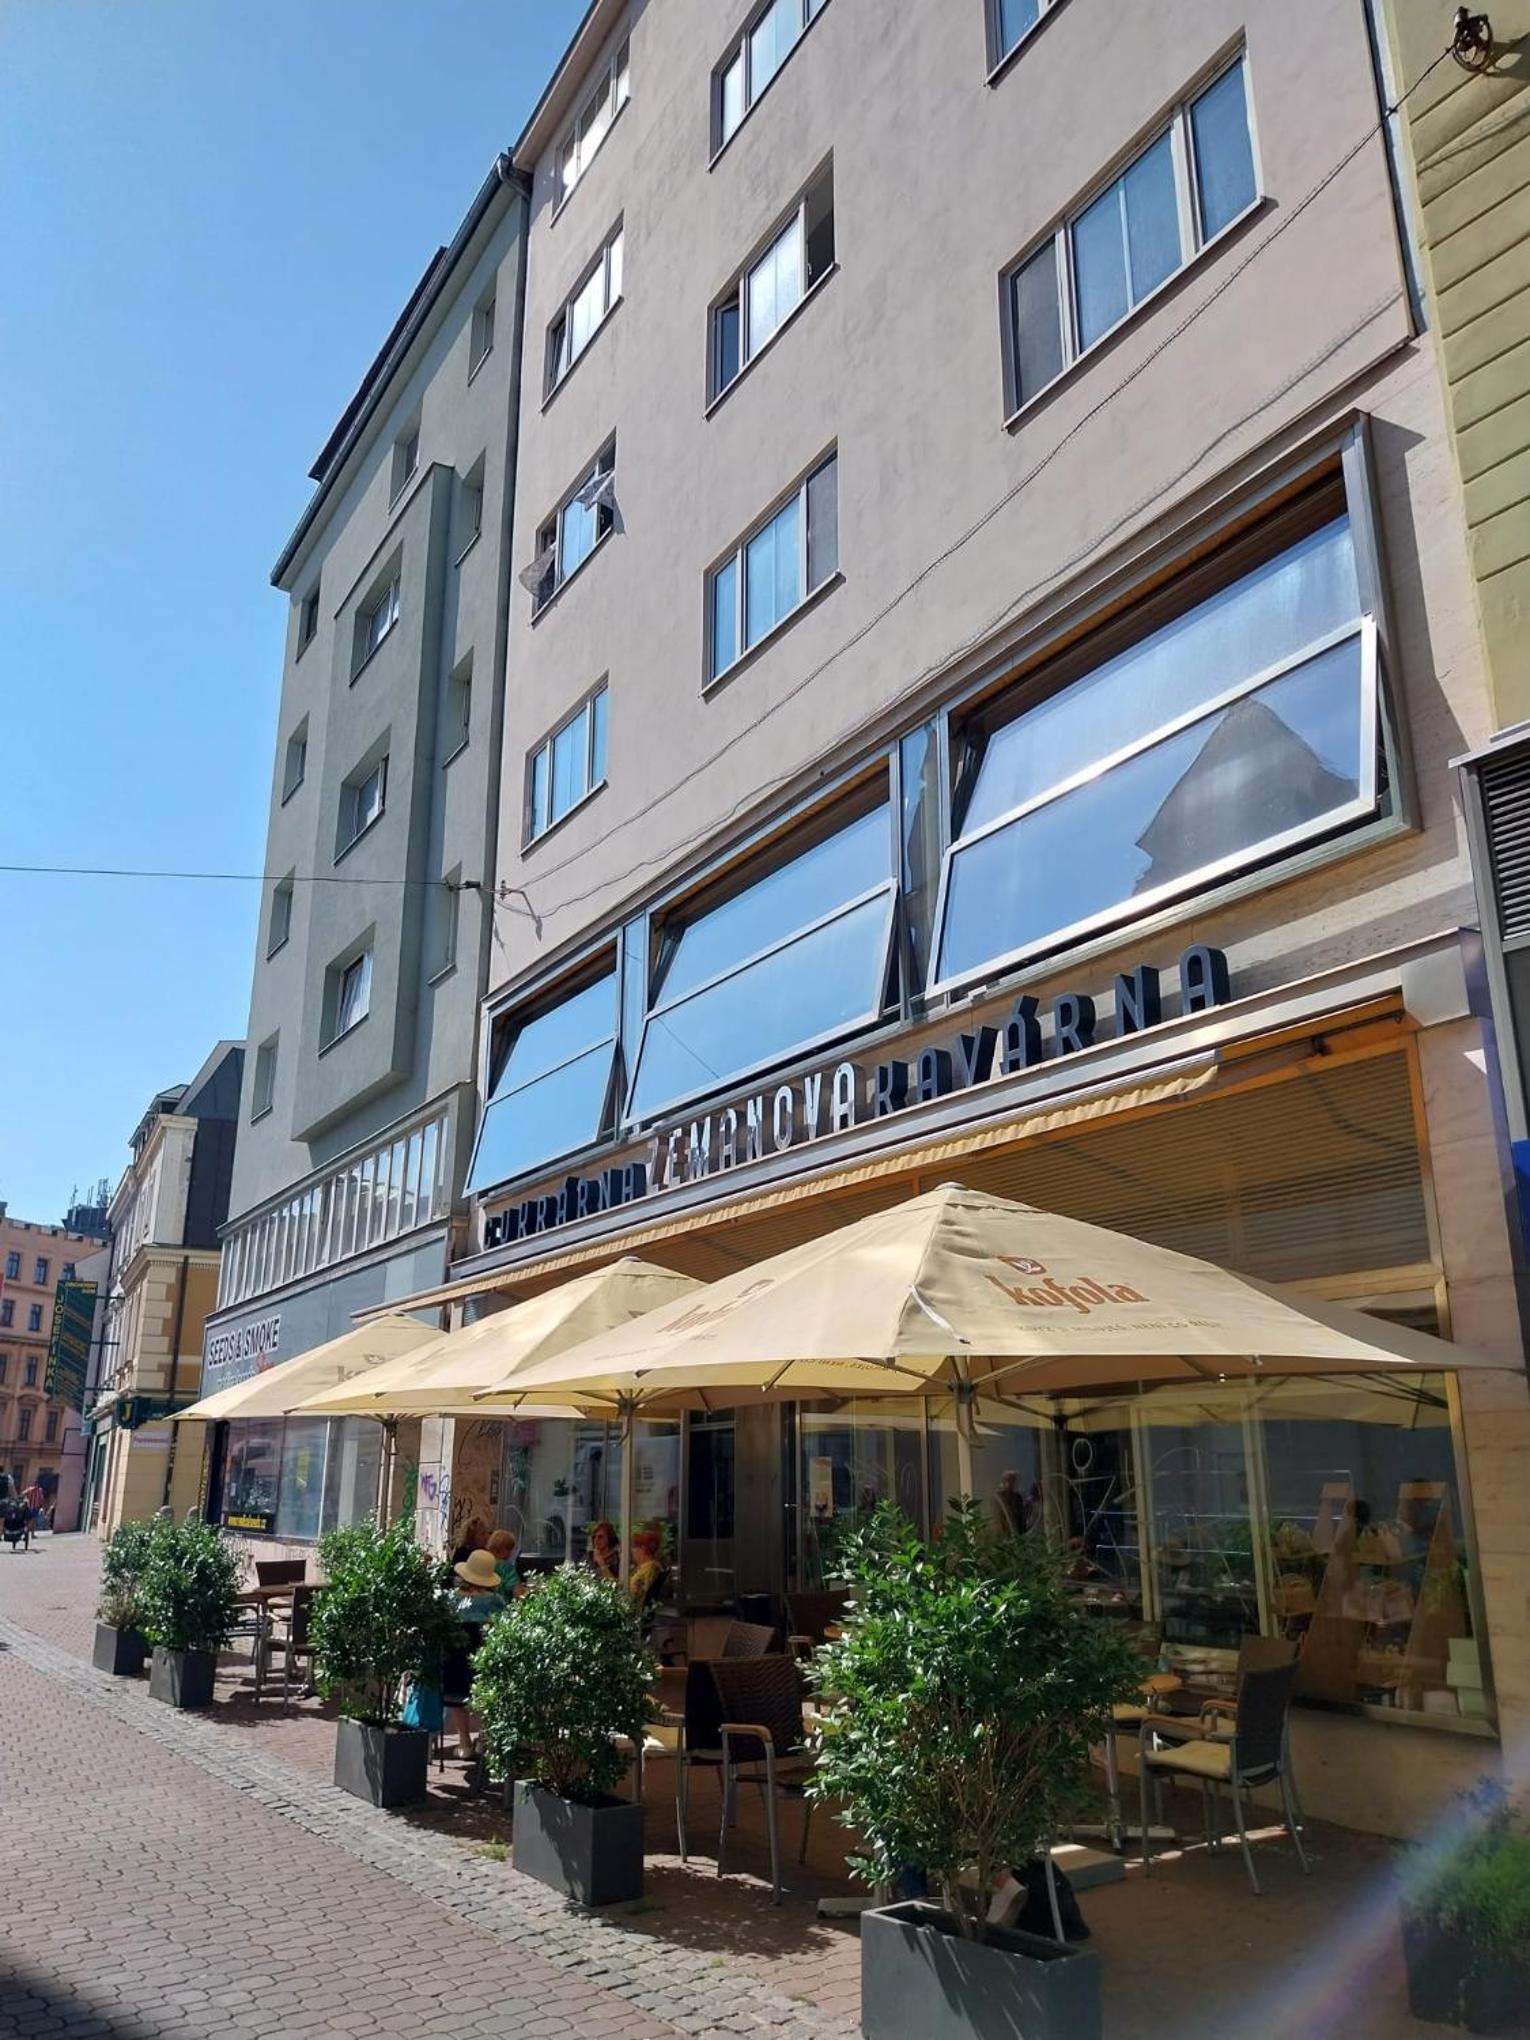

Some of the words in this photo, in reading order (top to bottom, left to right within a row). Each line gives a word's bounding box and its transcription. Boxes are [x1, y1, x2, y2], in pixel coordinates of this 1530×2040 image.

[484, 1162, 645, 1248] CUKRÁRNA
[645, 1062, 857, 1195] ZEMANOVA
[875, 944, 1231, 1118] KAVÁRNA
[985, 1275, 1150, 1314] kofola
[208, 1332, 236, 1369] SEEDS
[235, 1328, 243, 1361] &
[243, 1314, 281, 1359] SMOKE
[123, 1403, 133, 1421] J
